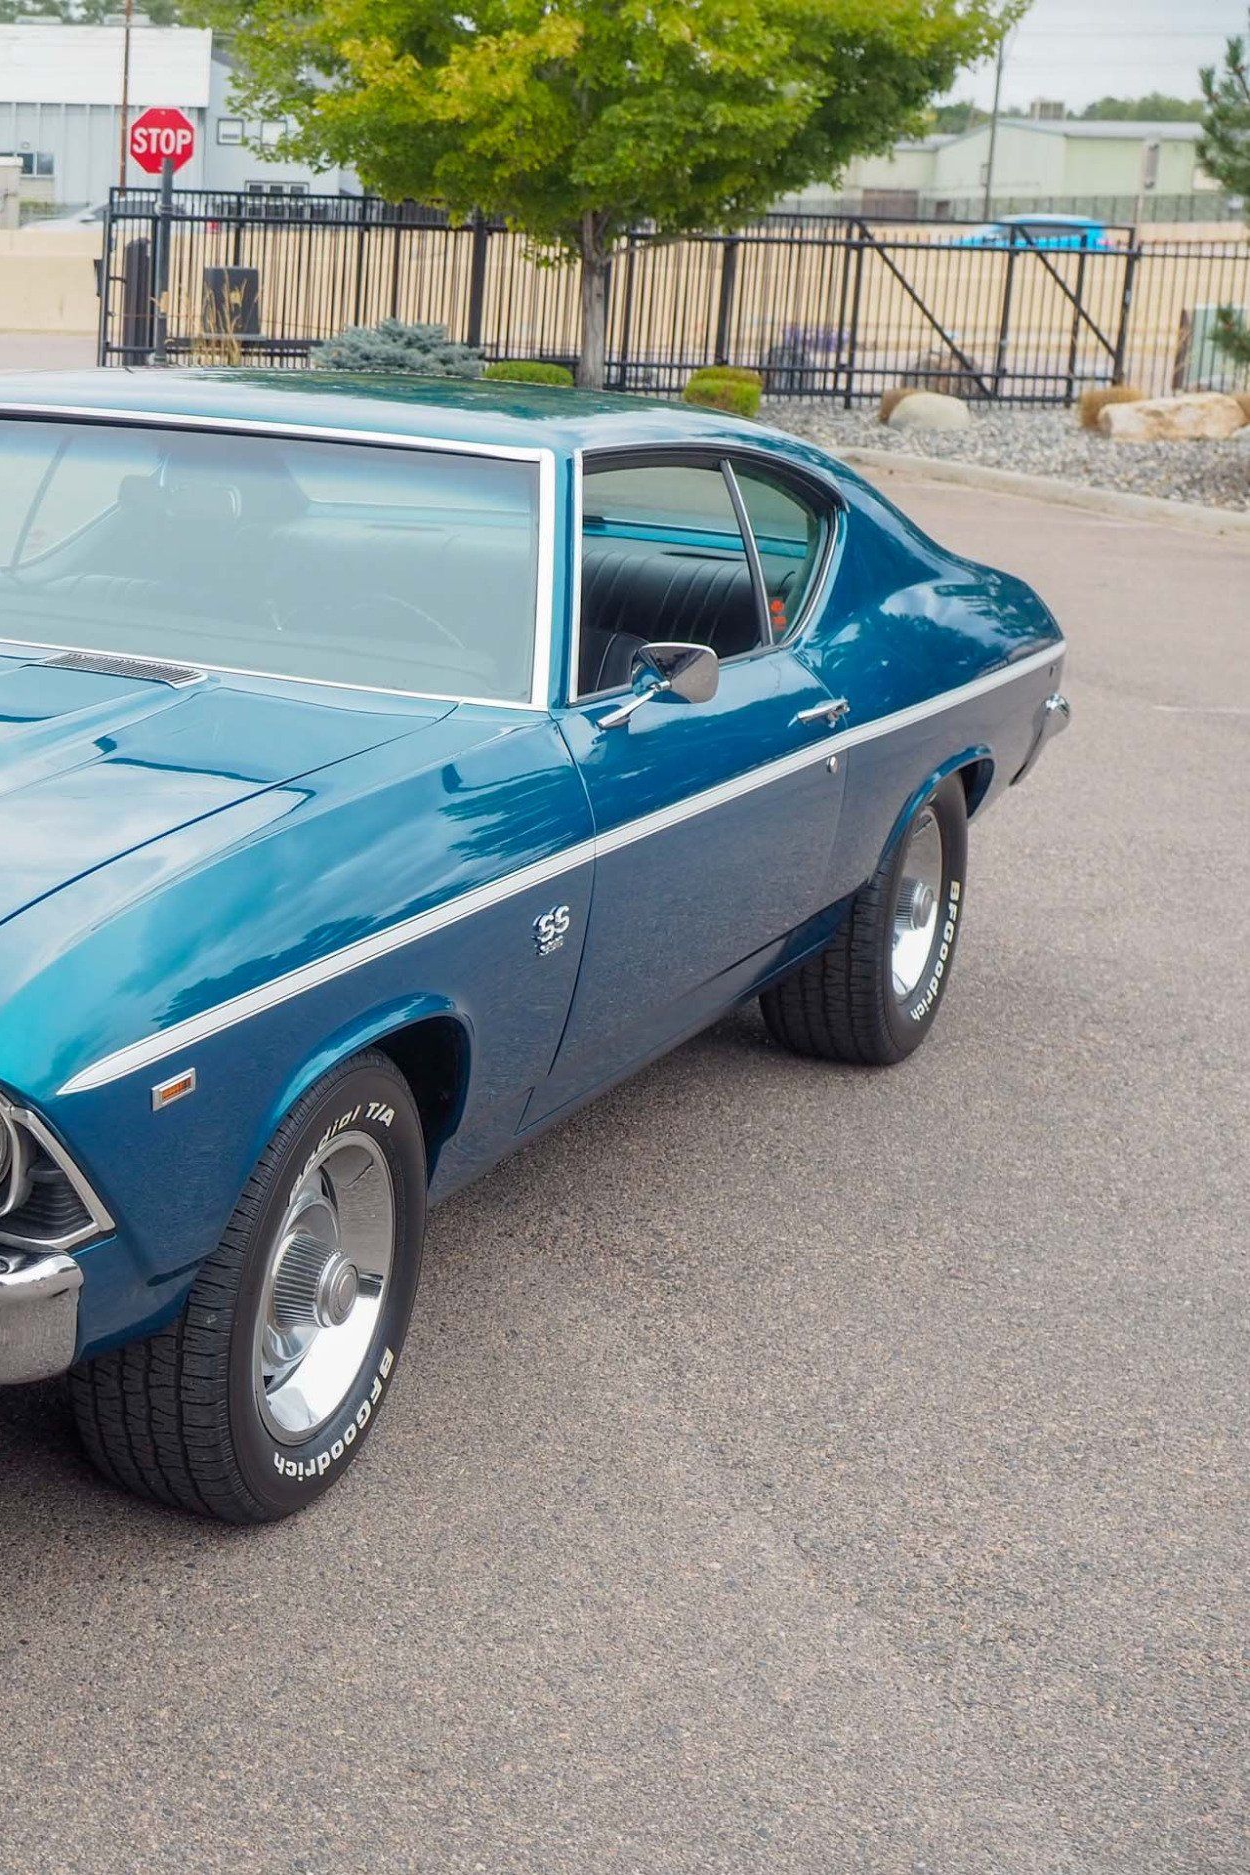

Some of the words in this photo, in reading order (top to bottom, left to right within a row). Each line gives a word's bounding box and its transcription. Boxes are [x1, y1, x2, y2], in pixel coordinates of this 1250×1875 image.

[132, 127, 192, 155] STOP
[536, 905, 570, 943] SS
[910, 880, 961, 1022] BFGoodrich
[366, 1102, 395, 1127] T/A
[273, 1347, 395, 1481] BFGoodrich
